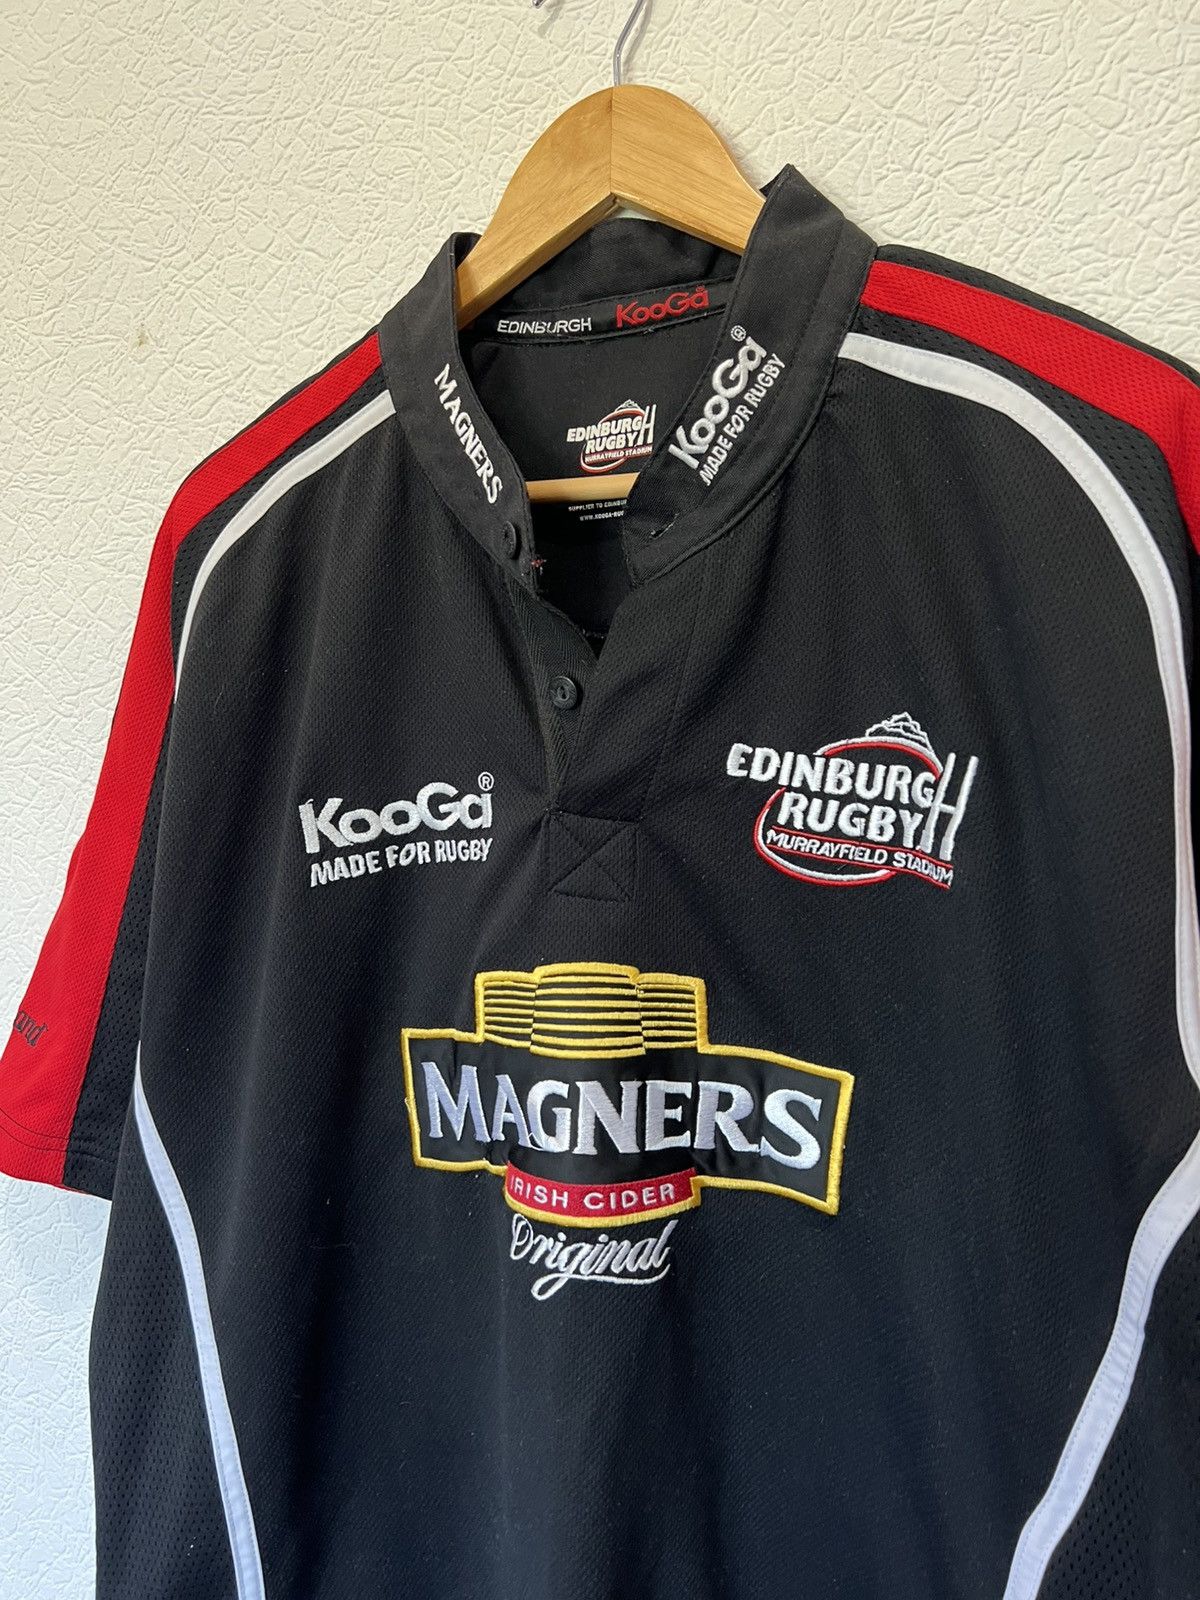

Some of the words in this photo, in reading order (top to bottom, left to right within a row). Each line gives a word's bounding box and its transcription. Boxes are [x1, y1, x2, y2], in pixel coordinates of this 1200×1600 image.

[497, 317, 593, 334] EDINBURGH
[434, 363, 503, 504] MAGNERS
[566, 404, 657, 446] EDINBURGH
[585, 431, 638, 454] RUGBY
[699, 434, 733, 486] MADE
[723, 404, 754, 438] FOR
[743, 353, 786, 408] RUGBY
[568, 503, 595, 512] SUPPLIER
[726, 742, 979, 862] EDINBURGH
[776, 791, 924, 849] RUGBY
[310, 850, 383, 888] MADE
[385, 841, 432, 868] FOR
[434, 837, 494, 864] RUGBY
[765, 829, 889, 865] MURRAYFIELD
[892, 851, 954, 886] STADIUM
[421, 1061, 822, 1170] MAGNERS
[509, 1175, 569, 1209] IRISH
[583, 1182, 675, 1211] CIDER
[509, 1213, 679, 1301] Original
